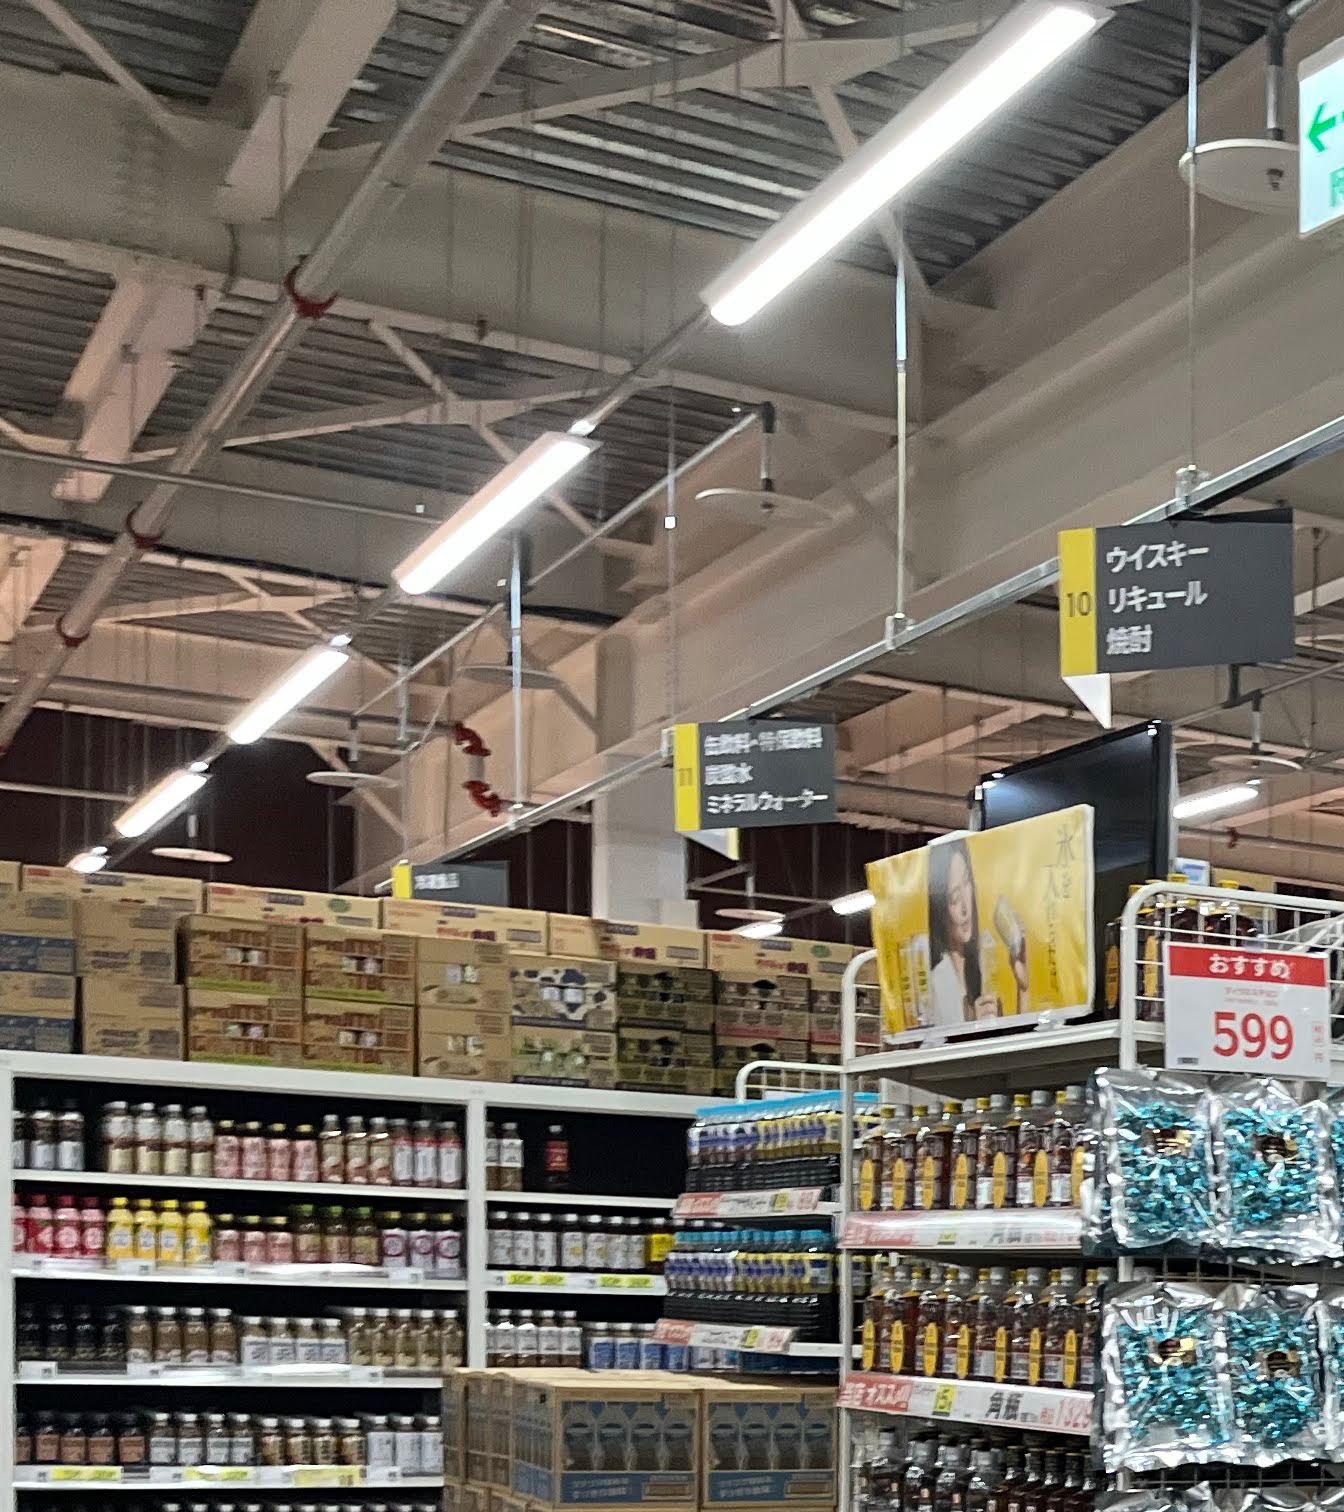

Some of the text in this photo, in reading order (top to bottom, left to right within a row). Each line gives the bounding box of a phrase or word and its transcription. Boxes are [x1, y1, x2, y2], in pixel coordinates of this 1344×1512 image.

[1106, 540, 1210, 573] ウイスキー
[1066, 591, 1092, 617] 10
[1108, 580, 1208, 614] リキュール
[1208, 953, 1294, 980] おすすめ
[1212, 1010, 1295, 1061] 599
